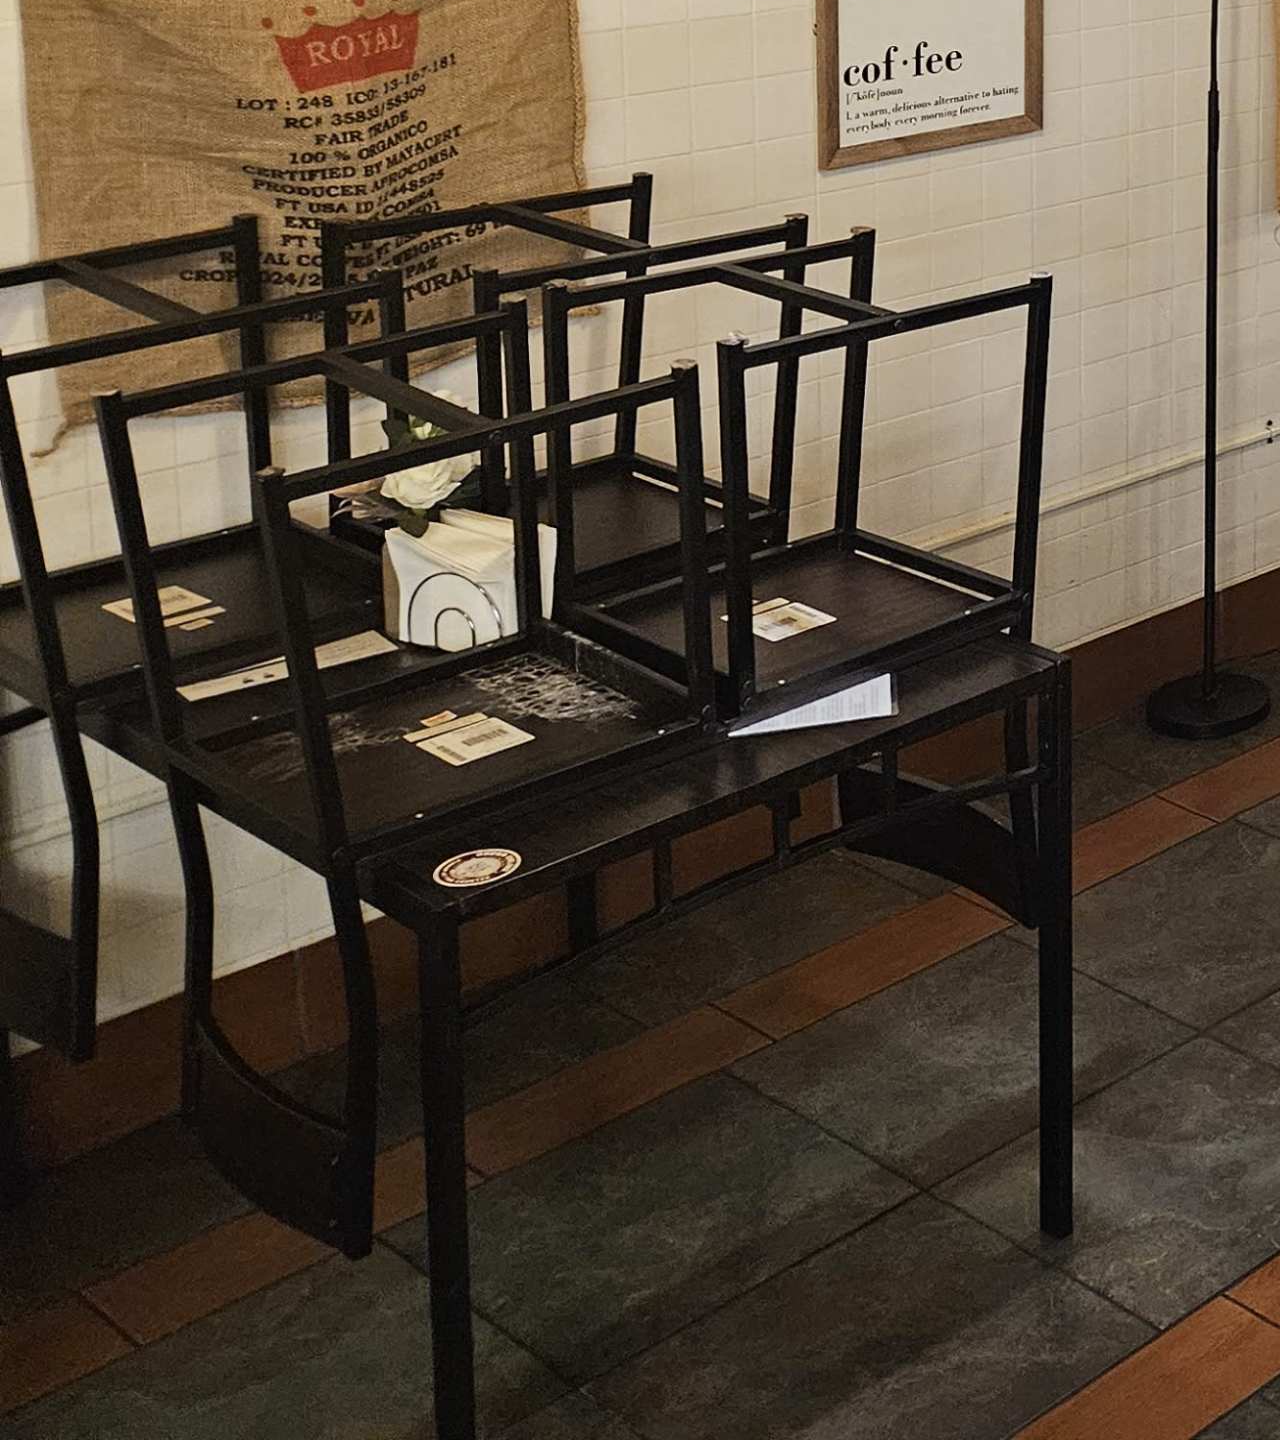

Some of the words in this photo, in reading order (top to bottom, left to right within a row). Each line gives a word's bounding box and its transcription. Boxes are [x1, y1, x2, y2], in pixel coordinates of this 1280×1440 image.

[305, 24, 404, 68] ROYAL
[236, 98, 277, 111] LOT
[297, 95, 334, 110] 248
[862, 108, 891, 118] warm,
[892, 101, 931, 113] delicious
[933, 91, 980, 106] alternative
[982, 90, 991, 98] to
[992, 86, 1019, 96] hating
[314, 130, 364, 146] FAIR
[367, 111, 409, 139] TRADE
[846, 118, 891, 133] everybody
[921, 109, 958, 122] morning
[242, 164, 356, 182] CERTIFIED
[363, 161, 383, 178] BY
[386, 124, 463, 169] MAYACERT
[289, 151, 326, 165] 100
[357, 120, 428, 160] ORGANICO
[252, 178, 367, 197] PRODUCER
[308, 202, 348, 214] USA
[355, 201, 374, 214] ID
[404, 264, 475, 303] TURAL
